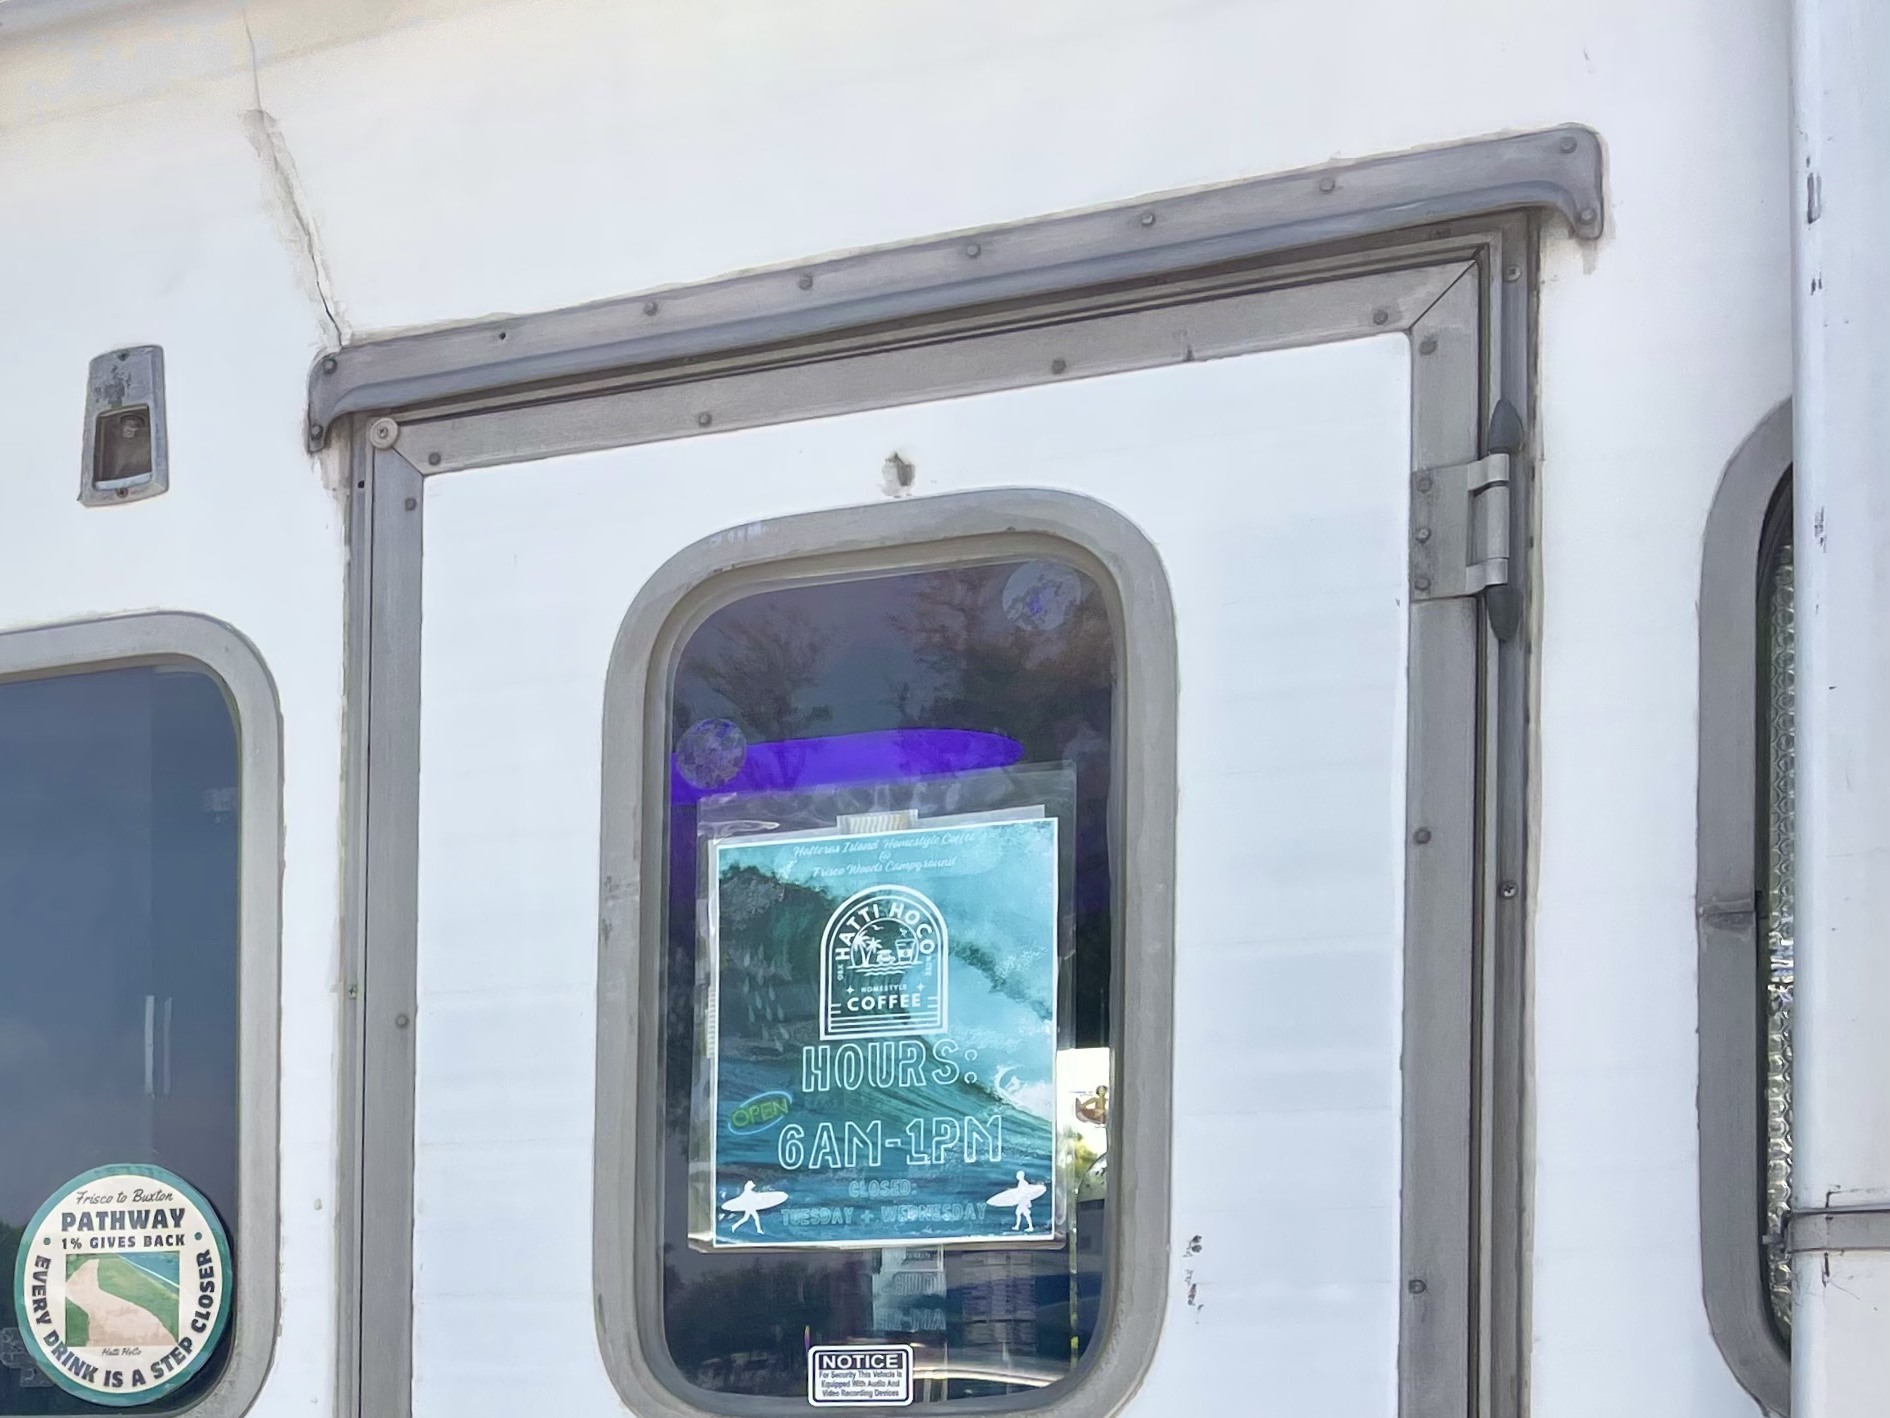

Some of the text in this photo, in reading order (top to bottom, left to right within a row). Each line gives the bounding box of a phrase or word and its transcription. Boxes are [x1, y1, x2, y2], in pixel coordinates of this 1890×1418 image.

[842, 843, 878, 853] Island
[835, 902, 935, 961] HATTI HOCO
[847, 994, 921, 1011] COFFEE
[801, 1040, 978, 1093] HOURS:
[731, 1096, 789, 1127] OPEN
[778, 1115, 1003, 1170] 6AM-1PM
[76, 1189, 173, 1204] Frisco to Buxton
[61, 1208, 185, 1232] PATHWAY
[781, 1207, 854, 1226] TUESDAY
[881, 1203, 987, 1222] WEDNESDAY
[62, 1234, 185, 1250] 1% GIVES BACK
[31, 1249, 215, 1388] EVERY DRINK IS A STEP CLOSER
[823, 1355, 898, 1368] NOTICE
[822, 1380, 851, 1388] Equipped
[831, 1371, 856, 1380] Security
[841, 1390, 873, 1398] Recording
